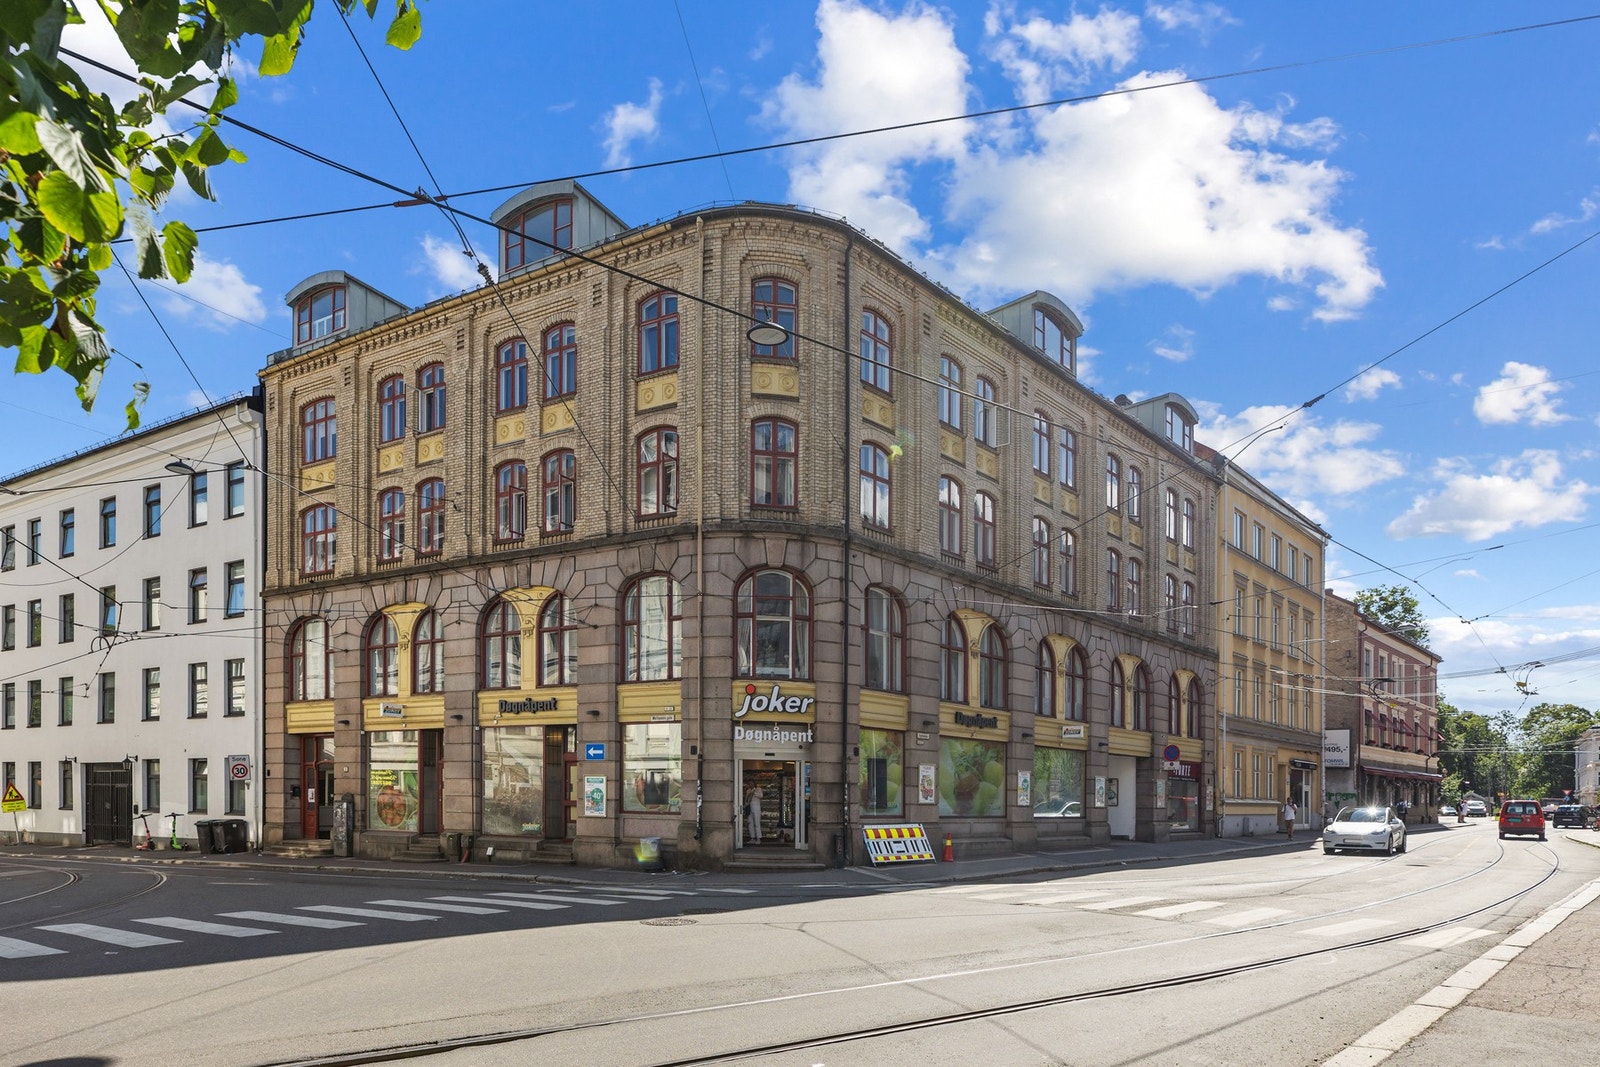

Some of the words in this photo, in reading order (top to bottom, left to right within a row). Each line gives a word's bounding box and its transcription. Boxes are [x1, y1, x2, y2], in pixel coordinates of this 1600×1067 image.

[499, 697, 558, 715] Døgnåpent
[734, 684, 815, 718] joker
[734, 726, 814, 744] Døgnåpent
[235, 767, 245, 775] 30
